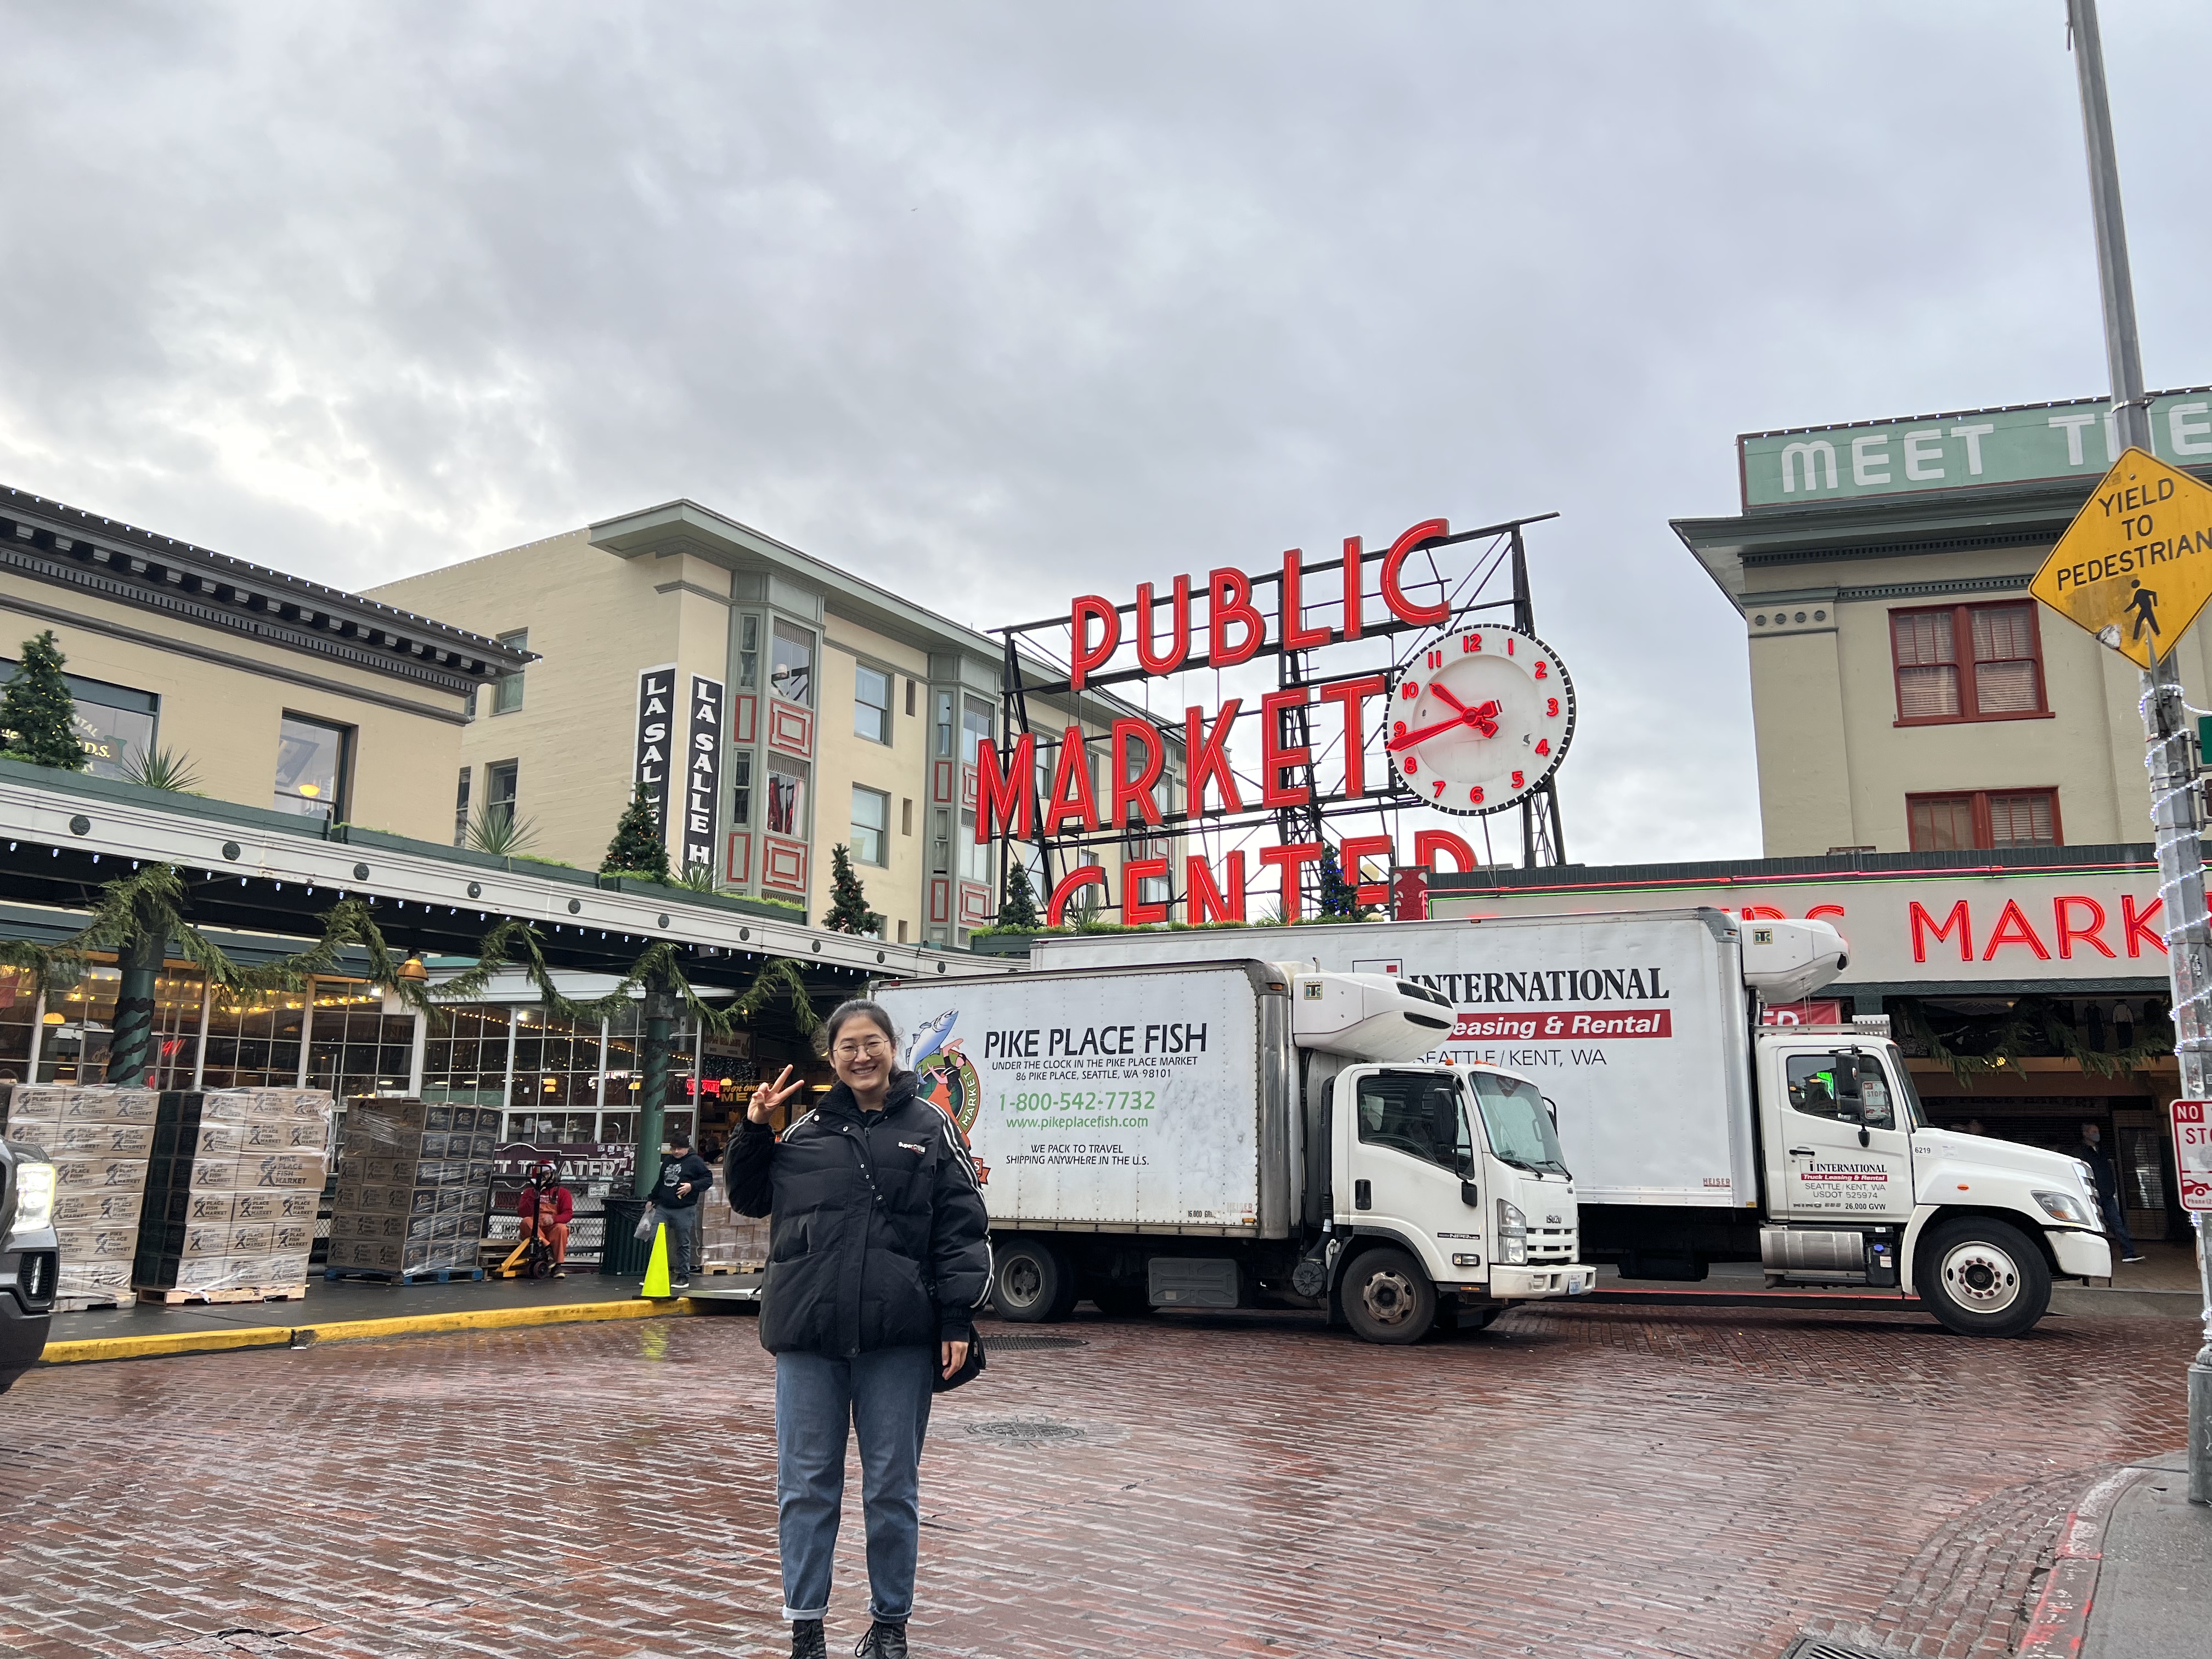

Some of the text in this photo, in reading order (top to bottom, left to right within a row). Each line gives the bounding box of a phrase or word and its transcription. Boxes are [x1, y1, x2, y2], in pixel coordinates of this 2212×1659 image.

[1781, 424, 1994, 493] MEET
[2098, 478, 2175, 517] YIELD
[2122, 515, 2153, 540] TO
[2057, 527, 2212, 591] PEDESTRIAN
[1071, 518, 1451, 690] PUBLIC
[1463, 634, 1481, 652] 12
[1508, 639, 1513, 655] 1
[1428, 651, 1441, 669] 11
[1535, 662, 1547, 678] 2
[1402, 681, 1418, 699] 10
[696, 682, 716, 724] LA
[1547, 698, 1559, 716] 3
[1394, 721, 1406, 736] 9
[640, 678, 667, 825] LA SAL
[1535, 739, 1550, 756] 4
[975, 675, 1386, 844] MARKET
[1404, 757, 1417, 774] 8
[689, 733, 713, 834] SALLE
[1511, 771, 1524, 788] 5
[1433, 781, 1446, 798] 7
[1470, 786, 1484, 804] 6
[1909, 893, 2212, 963] MARK
[1409, 968, 1669, 1003] NTERNATIONAL
[1453, 1013, 1661, 1039] easing & Rental
[985, 1023, 1207, 1058] PIKE PLACE FISH
[992, 1057, 1198, 1070] UNDER THE CLOCK IN THE PIKE PLACE MARKET
[1571, 1049, 1607, 1065] WA
[1016, 1069, 1171, 1081] 86 PIKE PLACE, SEATTLE, WA 98101
[961, 1071, 977, 1126] MARKET
[1000, 1091, 1155, 1111] 1-800-542-7732
[2177, 1106, 2199, 1119] NO
[1007, 1116, 1148, 1130] www.pikeplacefish.com
[2186, 1128, 2212, 1144] ST
[1048, 1145, 1070, 1153] PACK
[1089, 1144, 1123, 1153] TRAVEL
[1006, 1156, 1149, 1165] SHIPPING ANYWHERE IN THE U.S.
[1816, 1164, 1887, 1173] INTERNATIONAL
